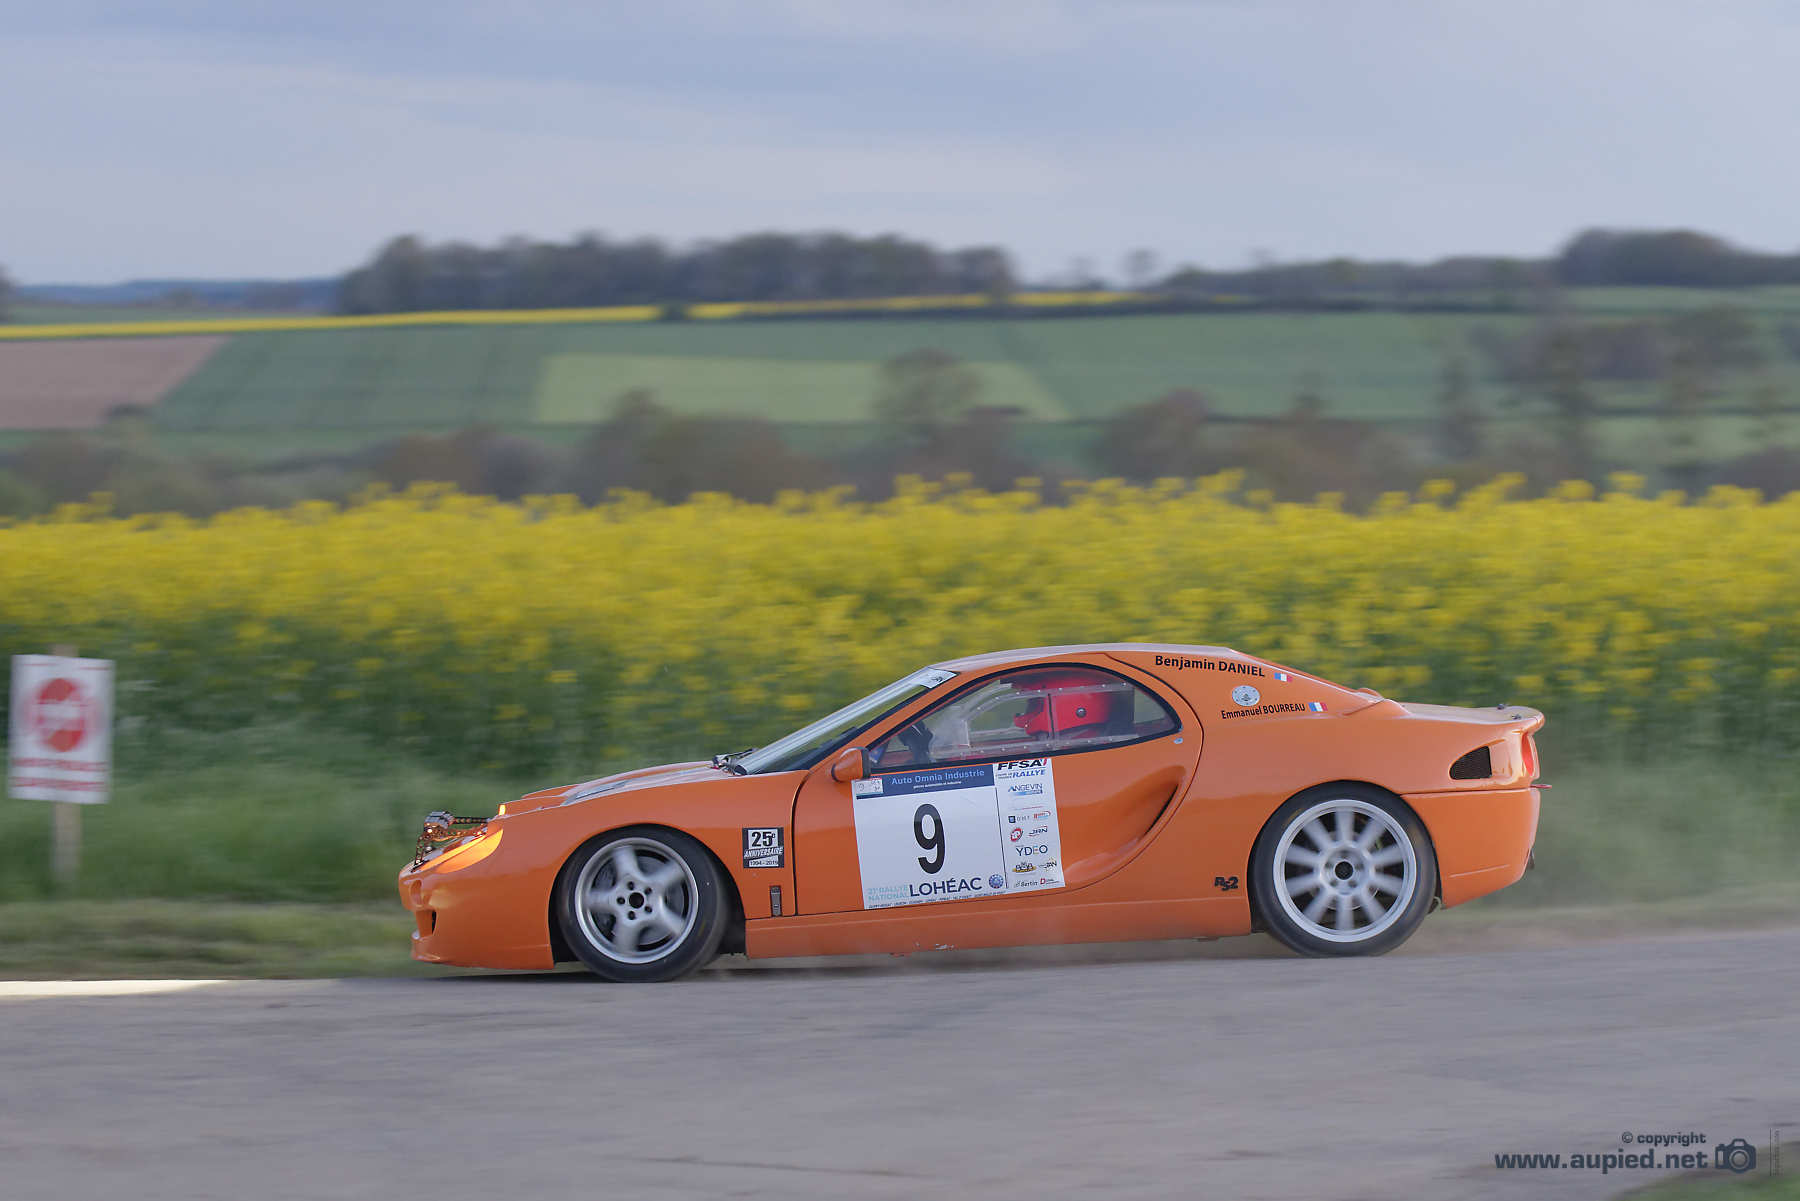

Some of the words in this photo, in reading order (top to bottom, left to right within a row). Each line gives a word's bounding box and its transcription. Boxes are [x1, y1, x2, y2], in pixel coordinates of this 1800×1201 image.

[1155, 655, 1215, 671] Benjamin
[1218, 661, 1266, 677] DANIEL
[1221, 708, 1262, 720] Emmanuel
[1263, 703, 1306, 715] BOURREAU
[998, 760, 1042, 770] FFSA
[891, 776, 913, 785] Auto
[914, 773, 943, 784] Omnia
[944, 769, 985, 780] Industrie
[1012, 769, 1046, 779] RALLYE
[913, 803, 946, 875] 9
[744, 847, 784, 858] ANNIVERSAIRE
[909, 877, 982, 897] LOHÉAC
